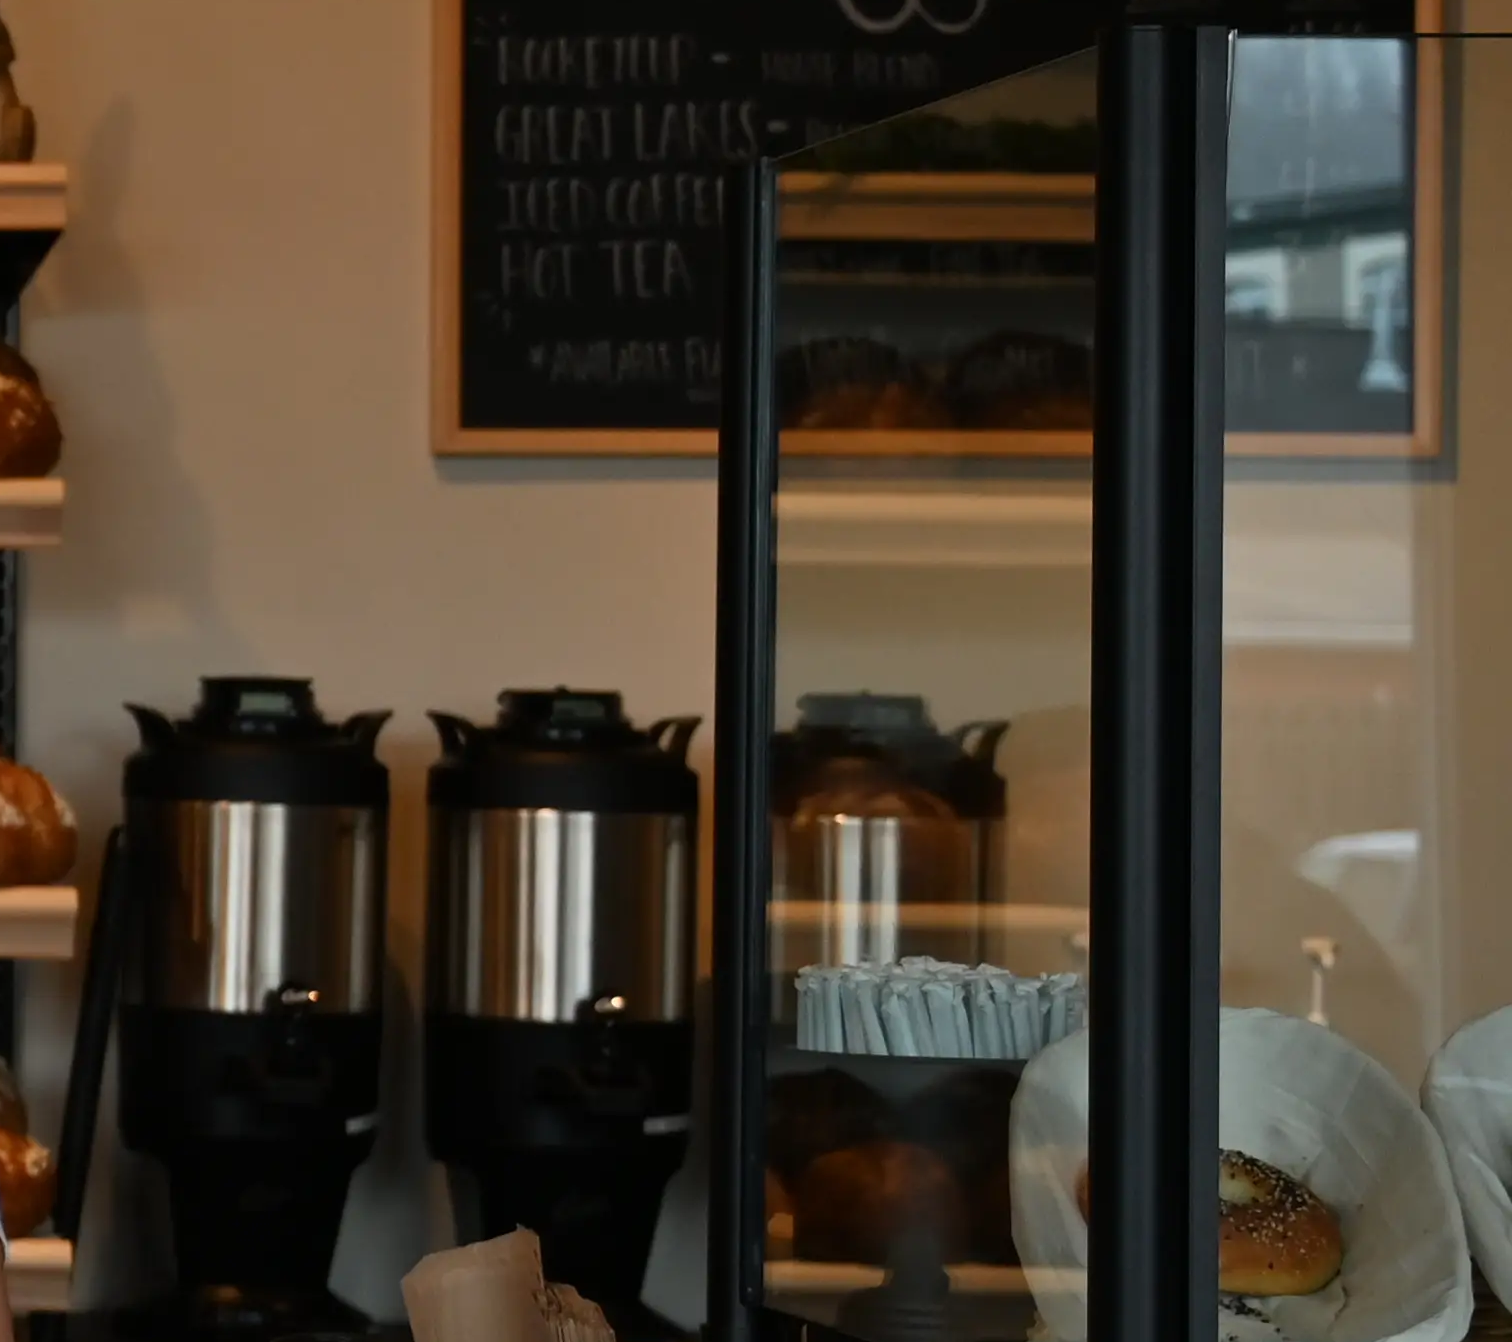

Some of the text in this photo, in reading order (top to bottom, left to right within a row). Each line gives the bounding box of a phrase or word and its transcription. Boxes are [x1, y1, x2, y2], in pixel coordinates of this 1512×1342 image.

[604, 172, 725, 234] COFFE
[501, 238, 694, 299] HOT TEA
